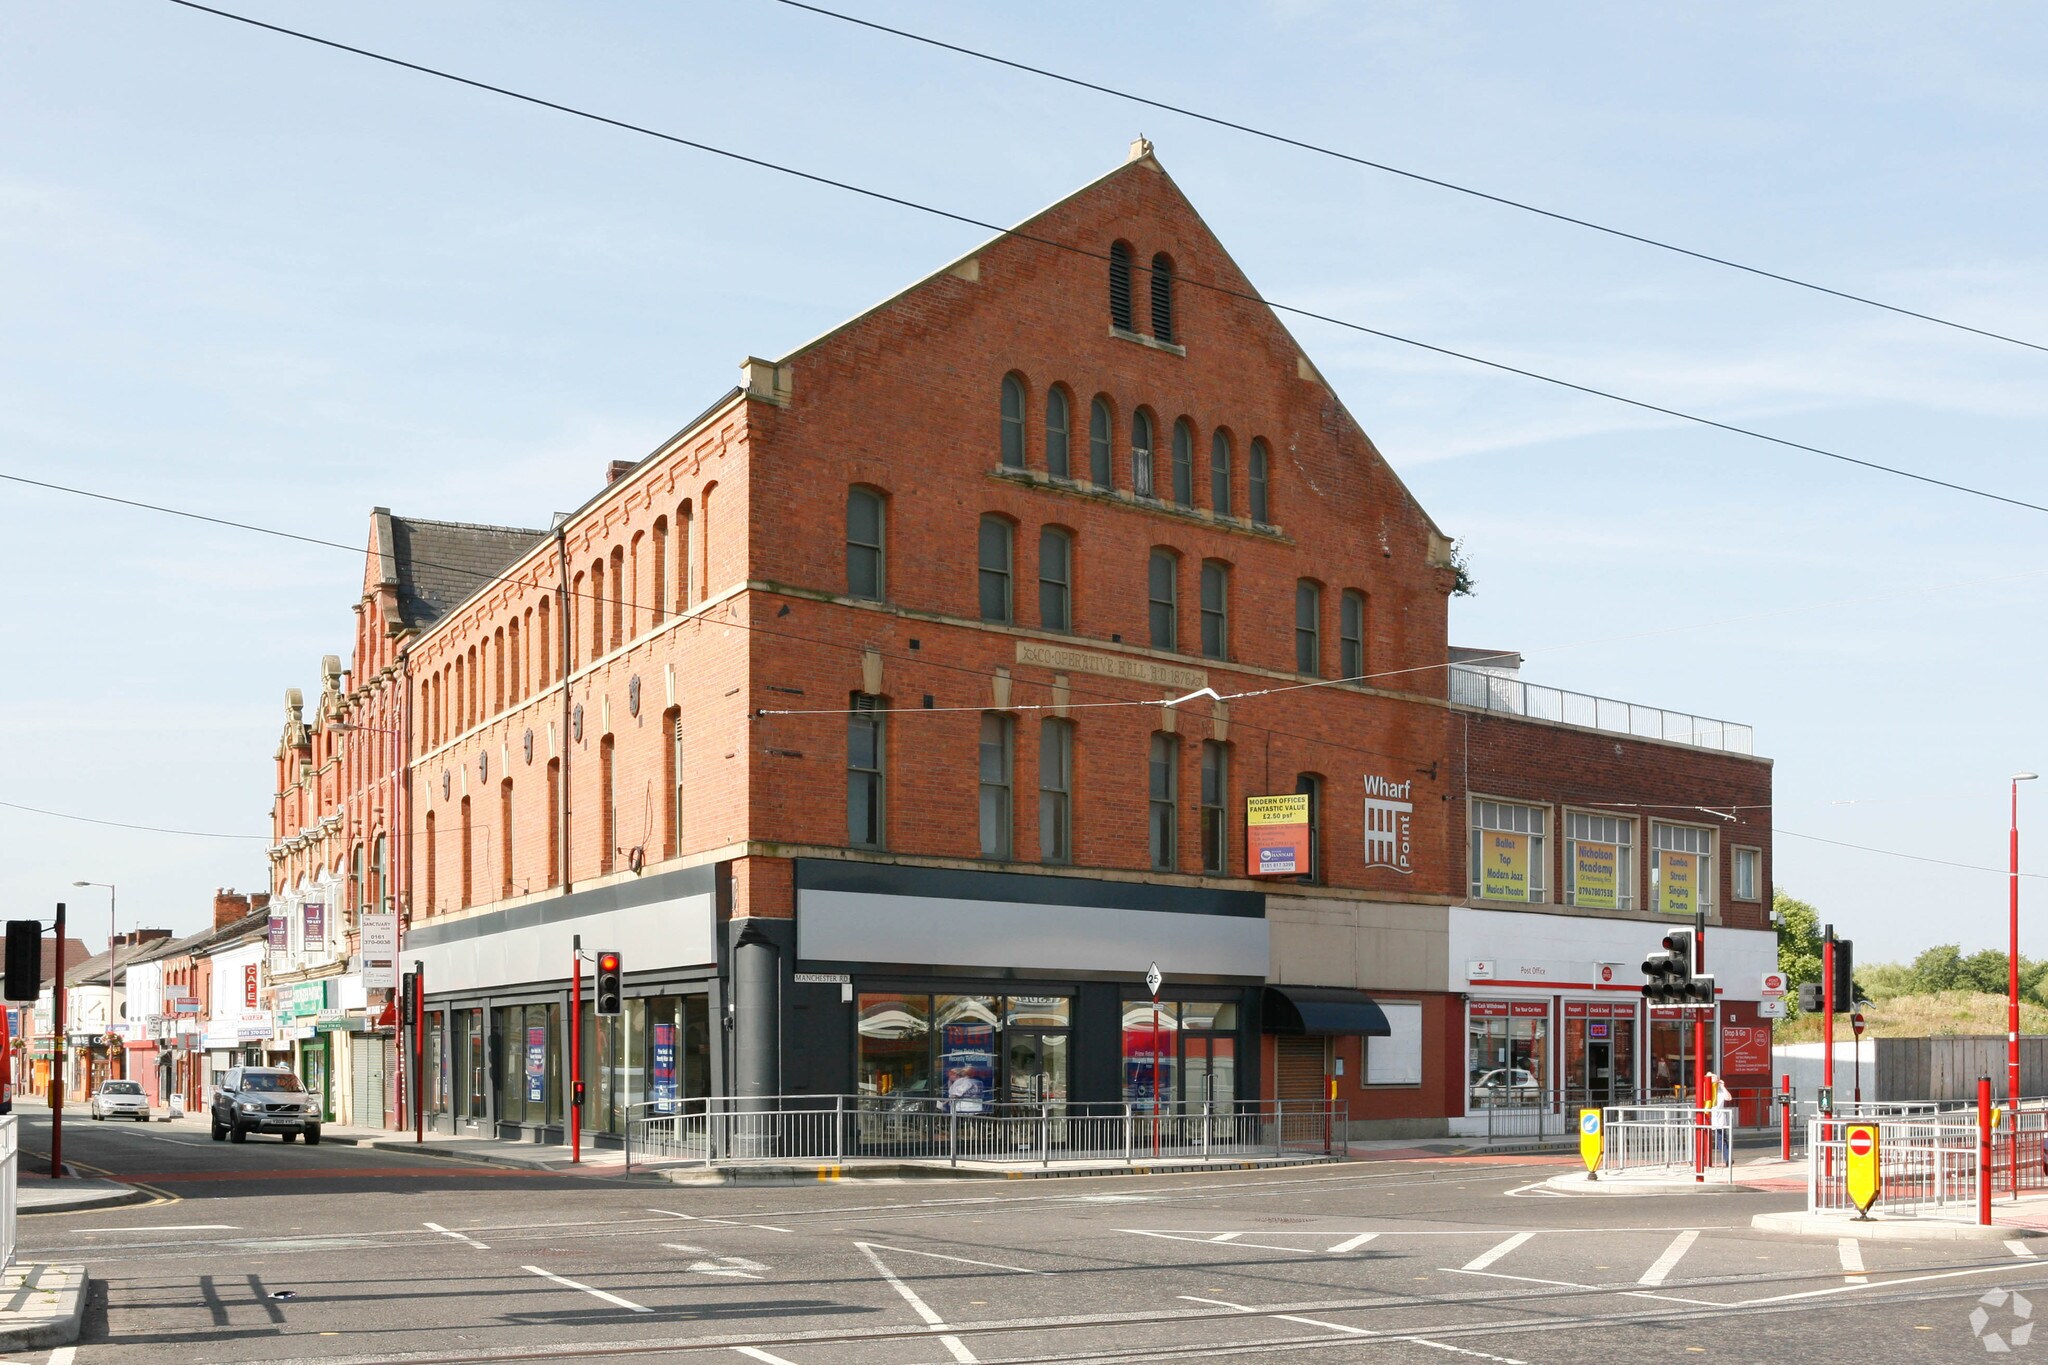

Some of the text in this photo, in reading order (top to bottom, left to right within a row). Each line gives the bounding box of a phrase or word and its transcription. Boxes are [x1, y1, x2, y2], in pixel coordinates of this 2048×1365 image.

[1119, 660, 1146, 678] HALL
[1363, 774, 1411, 799] Wharf
[1279, 796, 1306, 804] OFFICES
[1400, 815, 1410, 868] Point
[1495, 837, 1515, 849] Ballet
[1578, 845, 1613, 860] Nicholson
[1499, 853, 1511, 867] Tap
[1669, 856, 1688, 867] Zumba
[1487, 867, 1523, 881] Modern Jazz
[1579, 860, 1613, 877] Academy
[1670, 871, 1687, 881] Street
[1486, 884, 1524, 896] Musical Theatre
[1668, 885, 1688, 898] Singing
[1669, 899, 1688, 910] Drama
[1520, 966, 1546, 976] Post Office
[246, 967, 256, 1001] CAFE
[795, 974, 849, 983] MANCHESTER RD
[1148, 974, 1159, 984] 25
[947, 1025, 990, 1044] TO LET
[1724, 1029, 1746, 1038] Drop & Go
